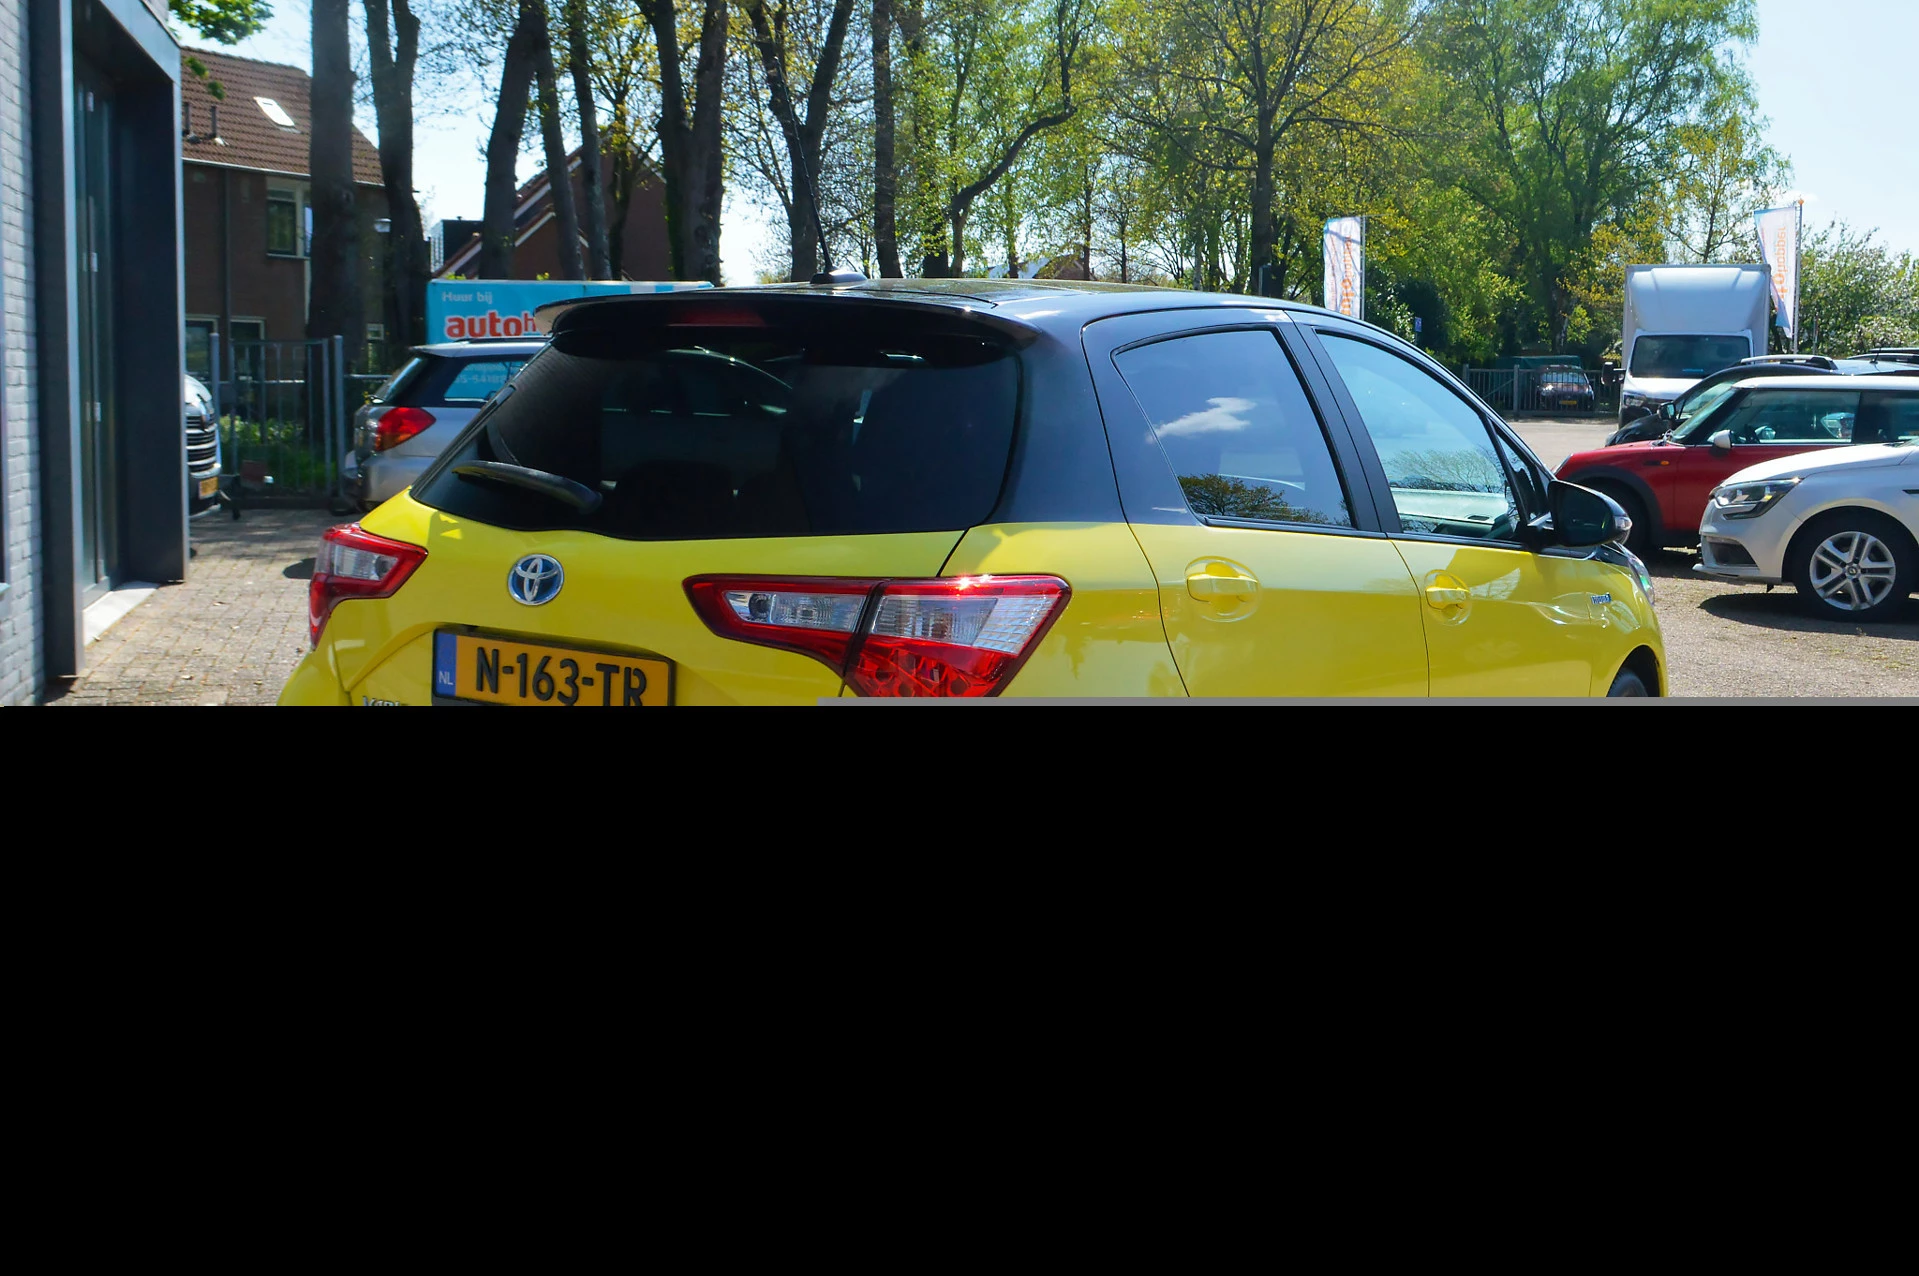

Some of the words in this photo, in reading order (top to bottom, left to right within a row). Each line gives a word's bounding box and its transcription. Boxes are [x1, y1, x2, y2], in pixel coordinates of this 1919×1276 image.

[441, 291, 473, 302] Huur
[476, 291, 493, 304] bij
[438, 670, 454, 686] NL
[476, 646, 647, 706] N-163-TR
